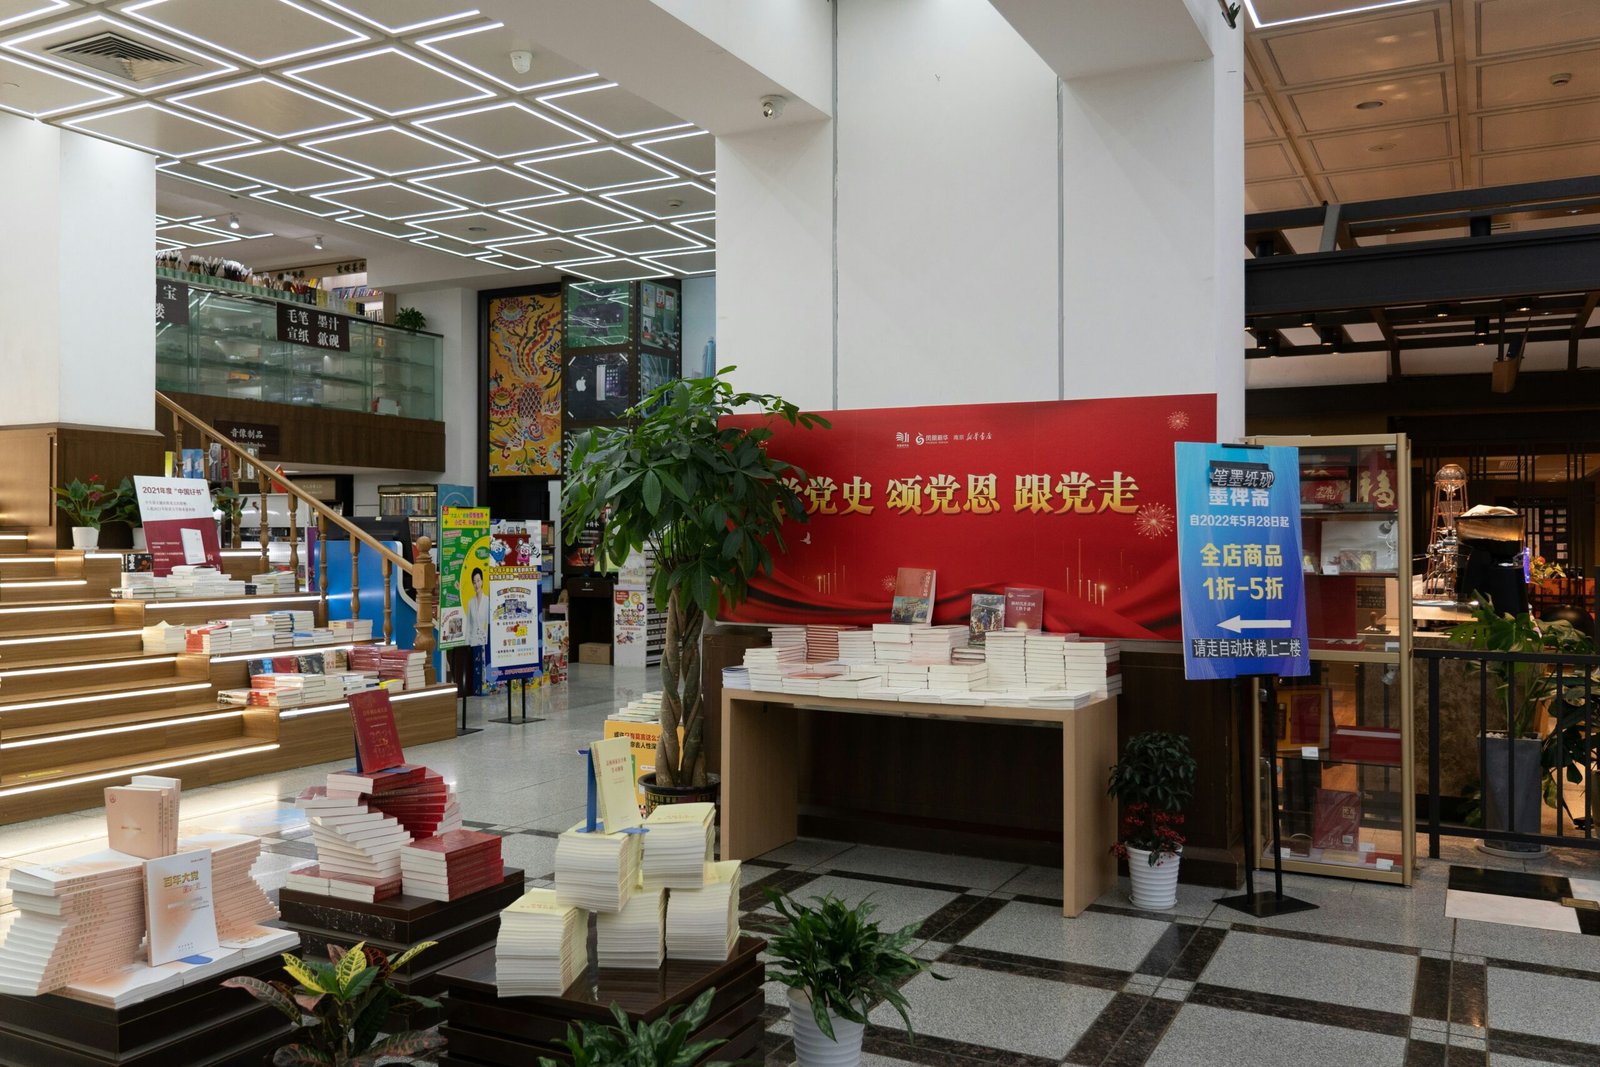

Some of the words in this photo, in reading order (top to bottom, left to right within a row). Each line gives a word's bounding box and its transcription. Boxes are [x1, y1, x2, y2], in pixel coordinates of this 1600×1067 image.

[287, 309, 309, 325] 毛笔
[317, 314, 340, 332] 墨汁
[287, 327, 309, 344] 宣纸
[230, 428, 264, 439] 音像制品
[1212, 468, 1275, 488] 笔墨纸砚
[885, 472, 1001, 516] 颂党恩
[1013, 470, 1139, 516] 跟党走
[1190, 514, 1290, 528] 自2022年5月28日起
[1200, 543, 1283, 568] 全店商品
[1202, 576, 1284, 601] 1折-5折
[1193, 638, 1302, 658] 请走自动扶梯上二楼
